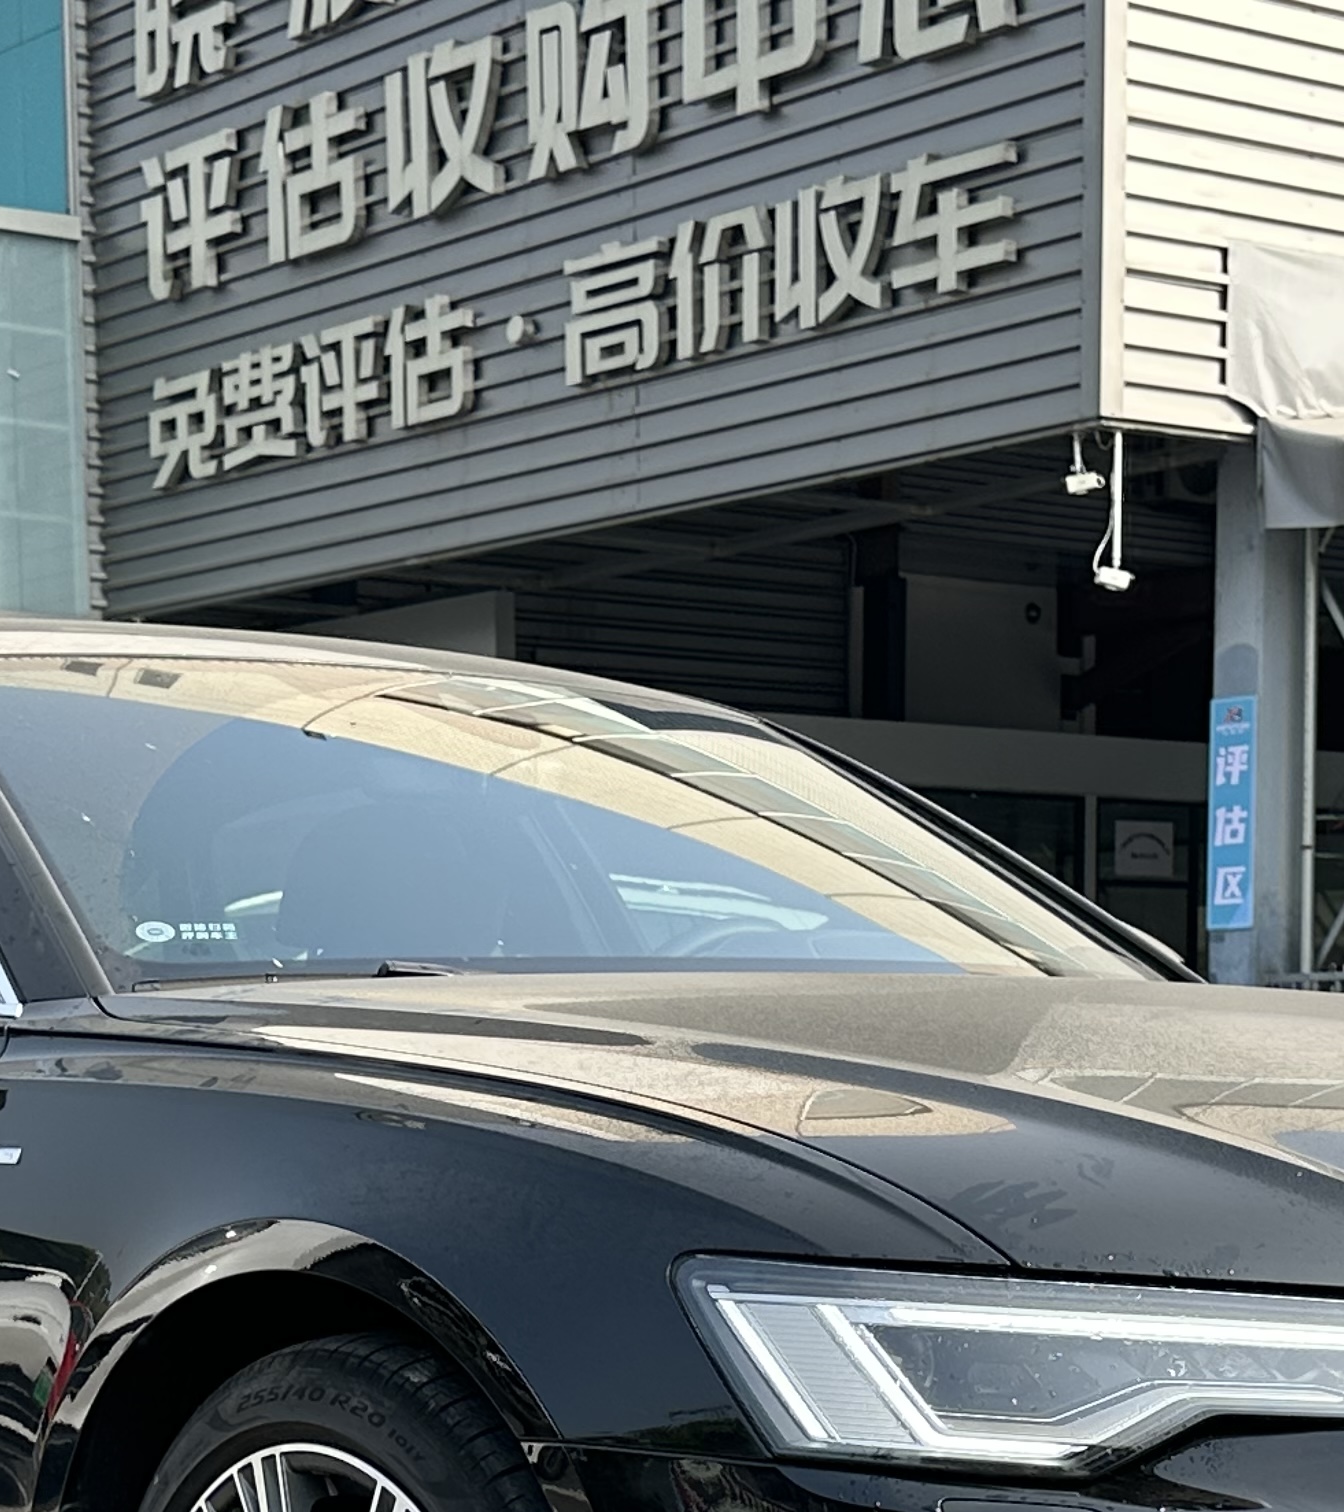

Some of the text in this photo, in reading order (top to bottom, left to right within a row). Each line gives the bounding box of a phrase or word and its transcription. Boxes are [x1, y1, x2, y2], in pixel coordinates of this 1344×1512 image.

[148, 142, 1018, 490] 免费评估·高价收车
[1214, 744, 1250, 905] 评估区
[236, 1383, 326, 1414] 255/40
[329, 1393, 386, 1429] R20
